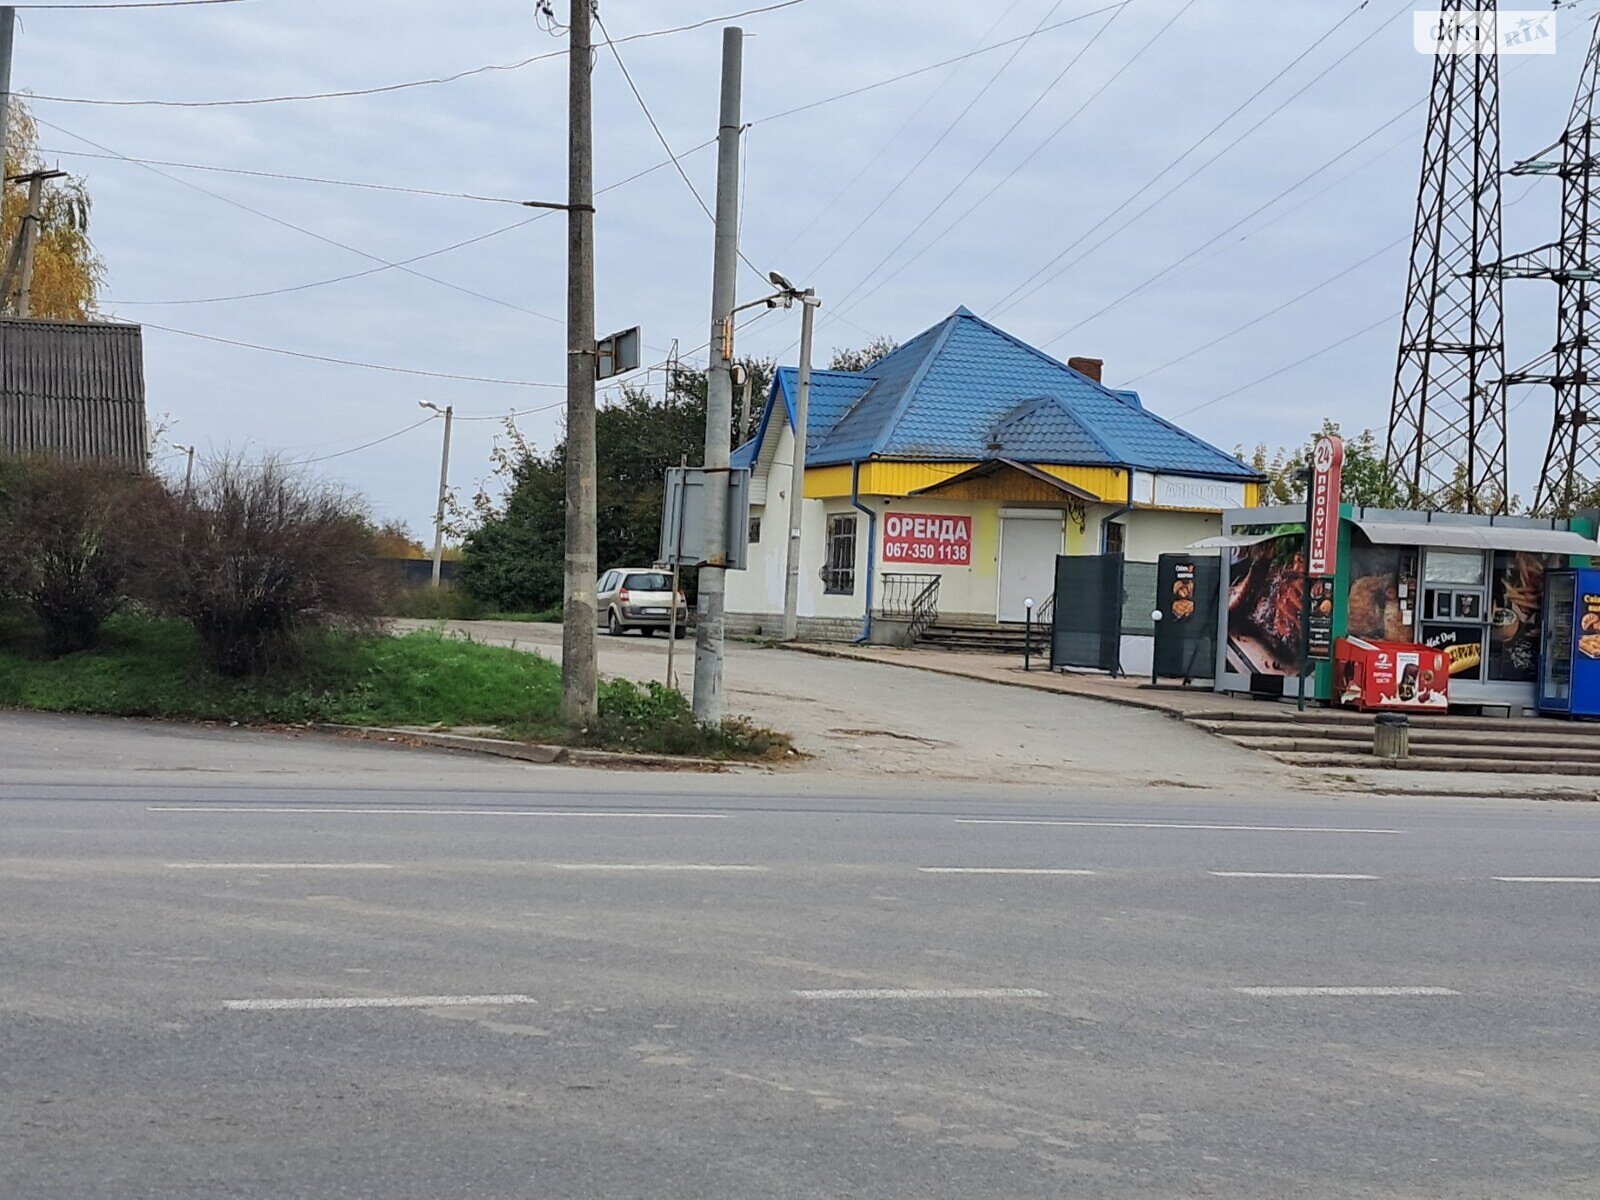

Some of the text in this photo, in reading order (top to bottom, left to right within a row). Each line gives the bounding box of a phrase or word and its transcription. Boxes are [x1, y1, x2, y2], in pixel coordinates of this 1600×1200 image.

[1318, 446, 1330, 464] 24
[1313, 474, 1327, 559] ПРОДУКТИ
[886, 517, 968, 543] ОРЕНДА
[886, 542, 967, 560] 067-350 1138
[1440, 631, 1457, 643] Dog
